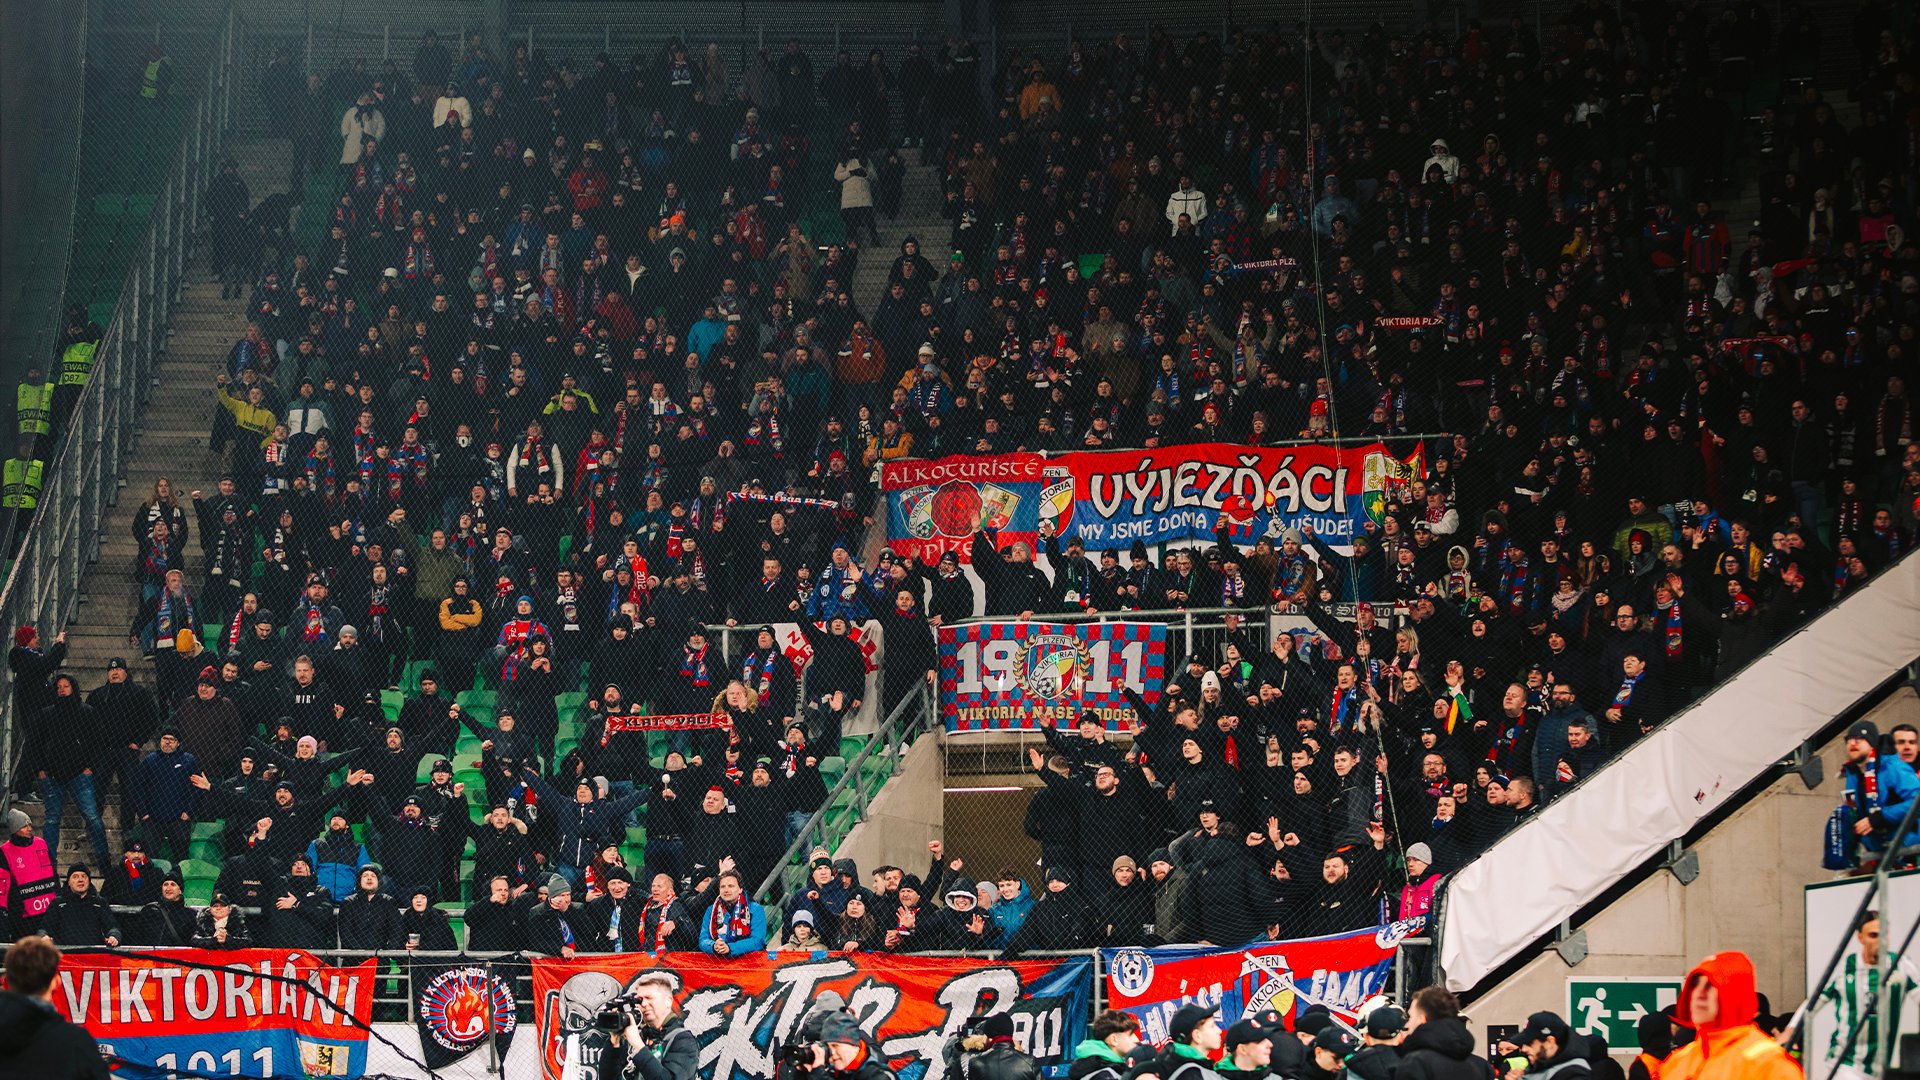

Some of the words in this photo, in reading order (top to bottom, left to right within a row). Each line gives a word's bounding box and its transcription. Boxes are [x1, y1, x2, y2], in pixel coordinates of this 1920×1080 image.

[1379, 317, 1420, 326] VIKTORIA
[887, 459, 1039, 483] ALKOTURISTÉ
[1090, 454, 1348, 519] VÝJEZĎÁCI
[1078, 522, 1101, 541] MY
[1109, 518, 1153, 540] JSME
[1158, 512, 1207, 530] DOMA
[956, 639, 1023, 694] 19
[1086, 639, 1145, 695] 11
[957, 705, 1027, 722] VIKTORIA
[1032, 702, 1076, 721] NAŠE
[60, 952, 360, 1026] VIKTORIÁNI
